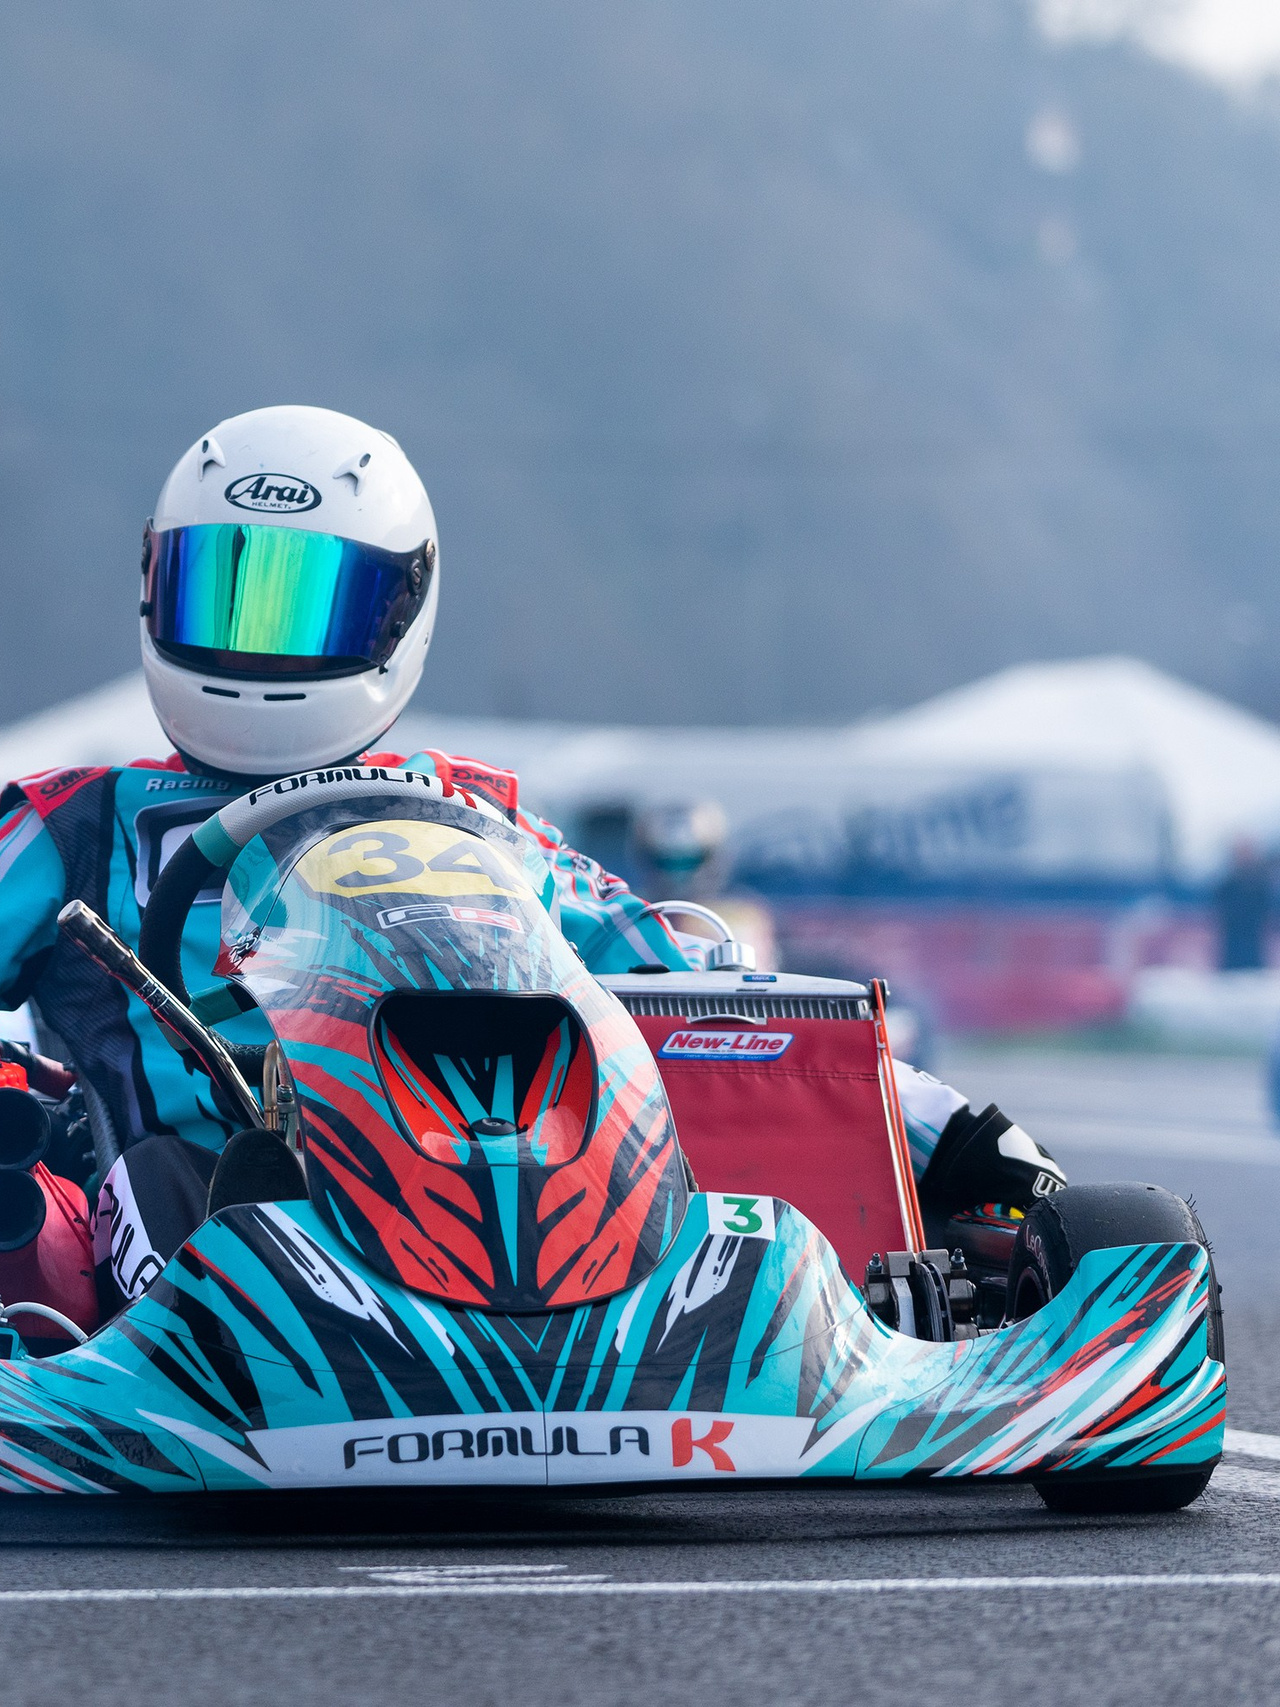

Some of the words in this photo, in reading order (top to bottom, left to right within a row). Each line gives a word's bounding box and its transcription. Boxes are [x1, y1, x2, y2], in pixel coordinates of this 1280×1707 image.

[228, 476, 311, 504] Arai
[145, 778, 231, 793] Racing
[249, 768, 431, 806] FORMULA
[451, 768, 508, 790] OMP
[327, 831, 526, 895] 34
[669, 1033, 784, 1051] New-Line
[723, 1195, 763, 1234] 3
[343, 1424, 651, 1470] FORMULA
[670, 1417, 738, 1473] K
